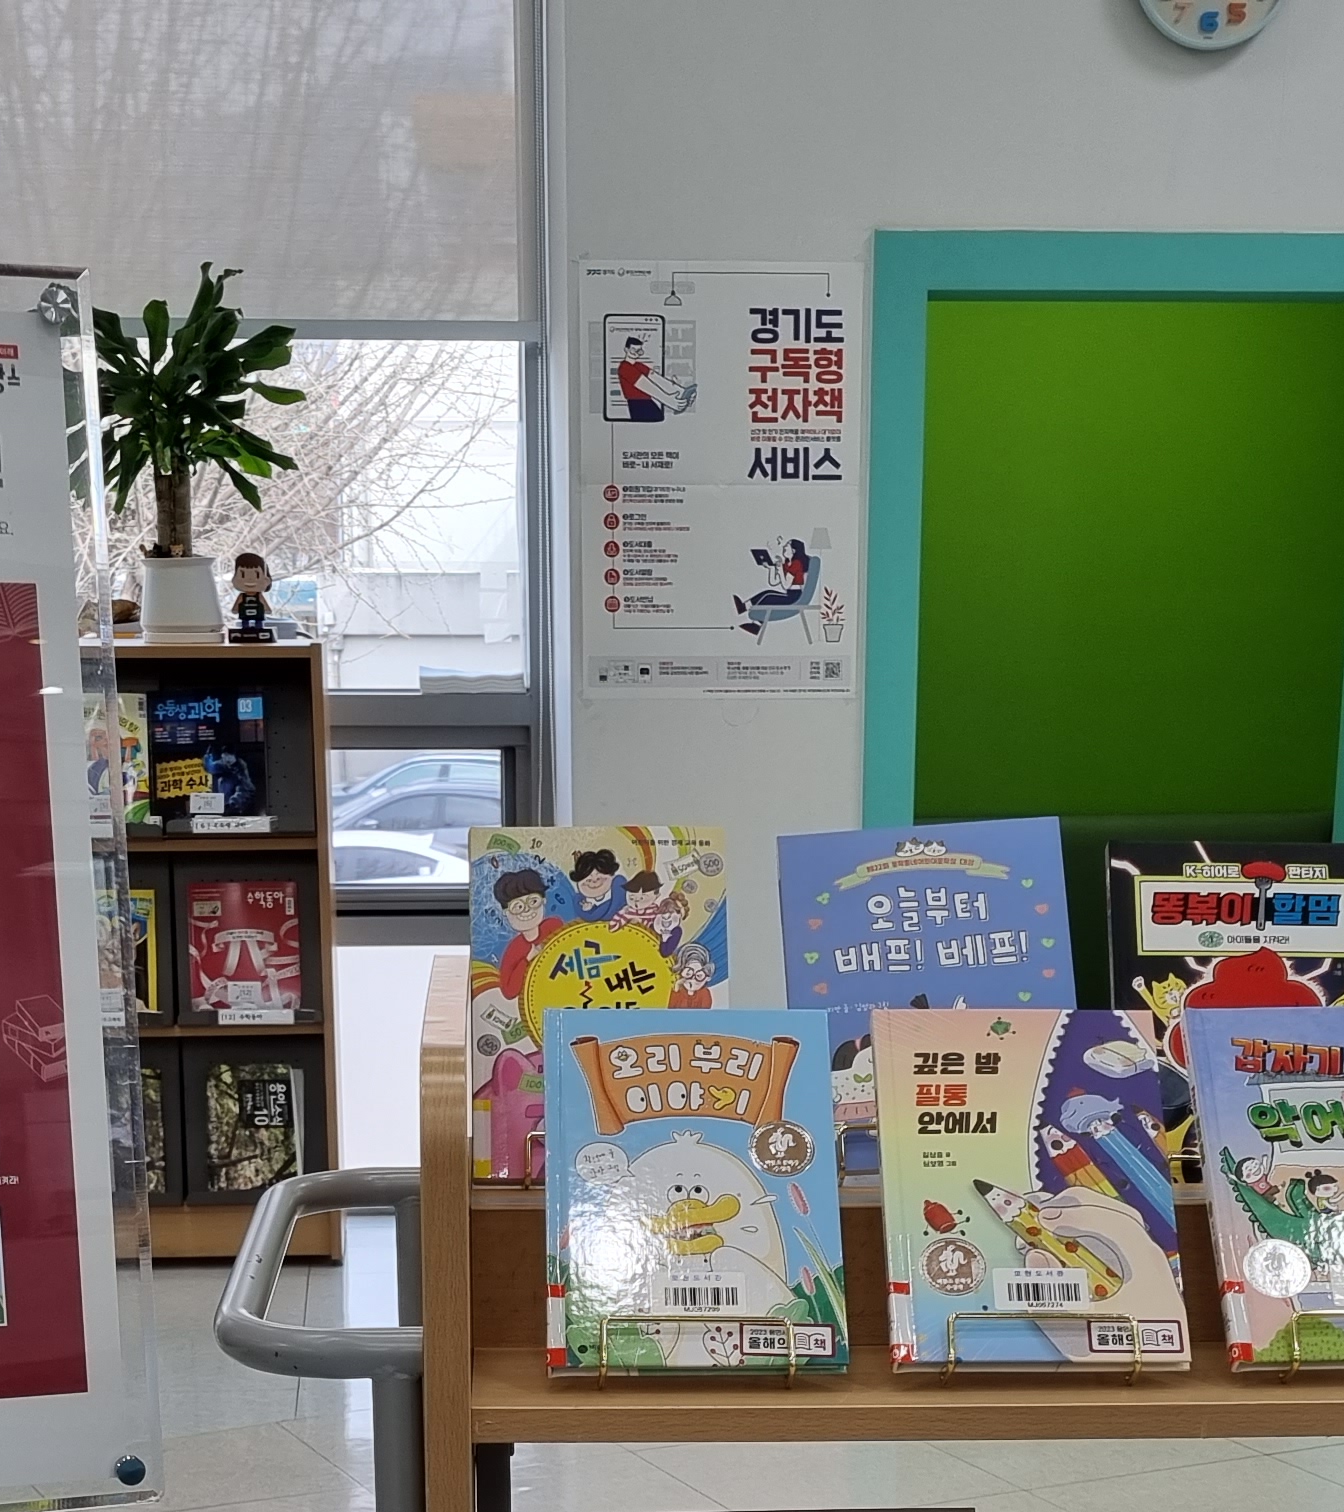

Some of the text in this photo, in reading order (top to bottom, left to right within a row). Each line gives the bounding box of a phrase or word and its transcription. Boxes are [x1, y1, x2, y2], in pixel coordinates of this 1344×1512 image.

[1200, 11, 1219, 33] 6
[1227, 3, 1247, 25] 5
[748, 307, 845, 344] 경기도
[748, 348, 844, 384] 구독형
[748, 387, 843, 423] 전자책
[747, 446, 843, 482] 서비스
[239, 700, 253, 713] 03
[160, 774, 209, 793] 과학 수사
[1185, 864, 1328, 879] K-히어로 판타지
[247, 891, 285, 909] 수학동아
[866, 886, 989, 932] 오늘부터
[1150, 890, 1342, 927] 똥볶이 할멈
[834, 930, 1029, 974] 배프! 베프!
[604, 961, 656, 995] 내는
[608, 1042, 765, 1081] 오리 부리
[912, 1052, 1001, 1075] 깊은 밤
[624, 1081, 751, 1115] 이야기
[914, 1083, 968, 1107] 필통
[254, 1110, 269, 1126] 10
[917, 1111, 998, 1135] 안에서
[813, 1338, 827, 1351] 책
[1161, 1333, 1174, 1346] 책
